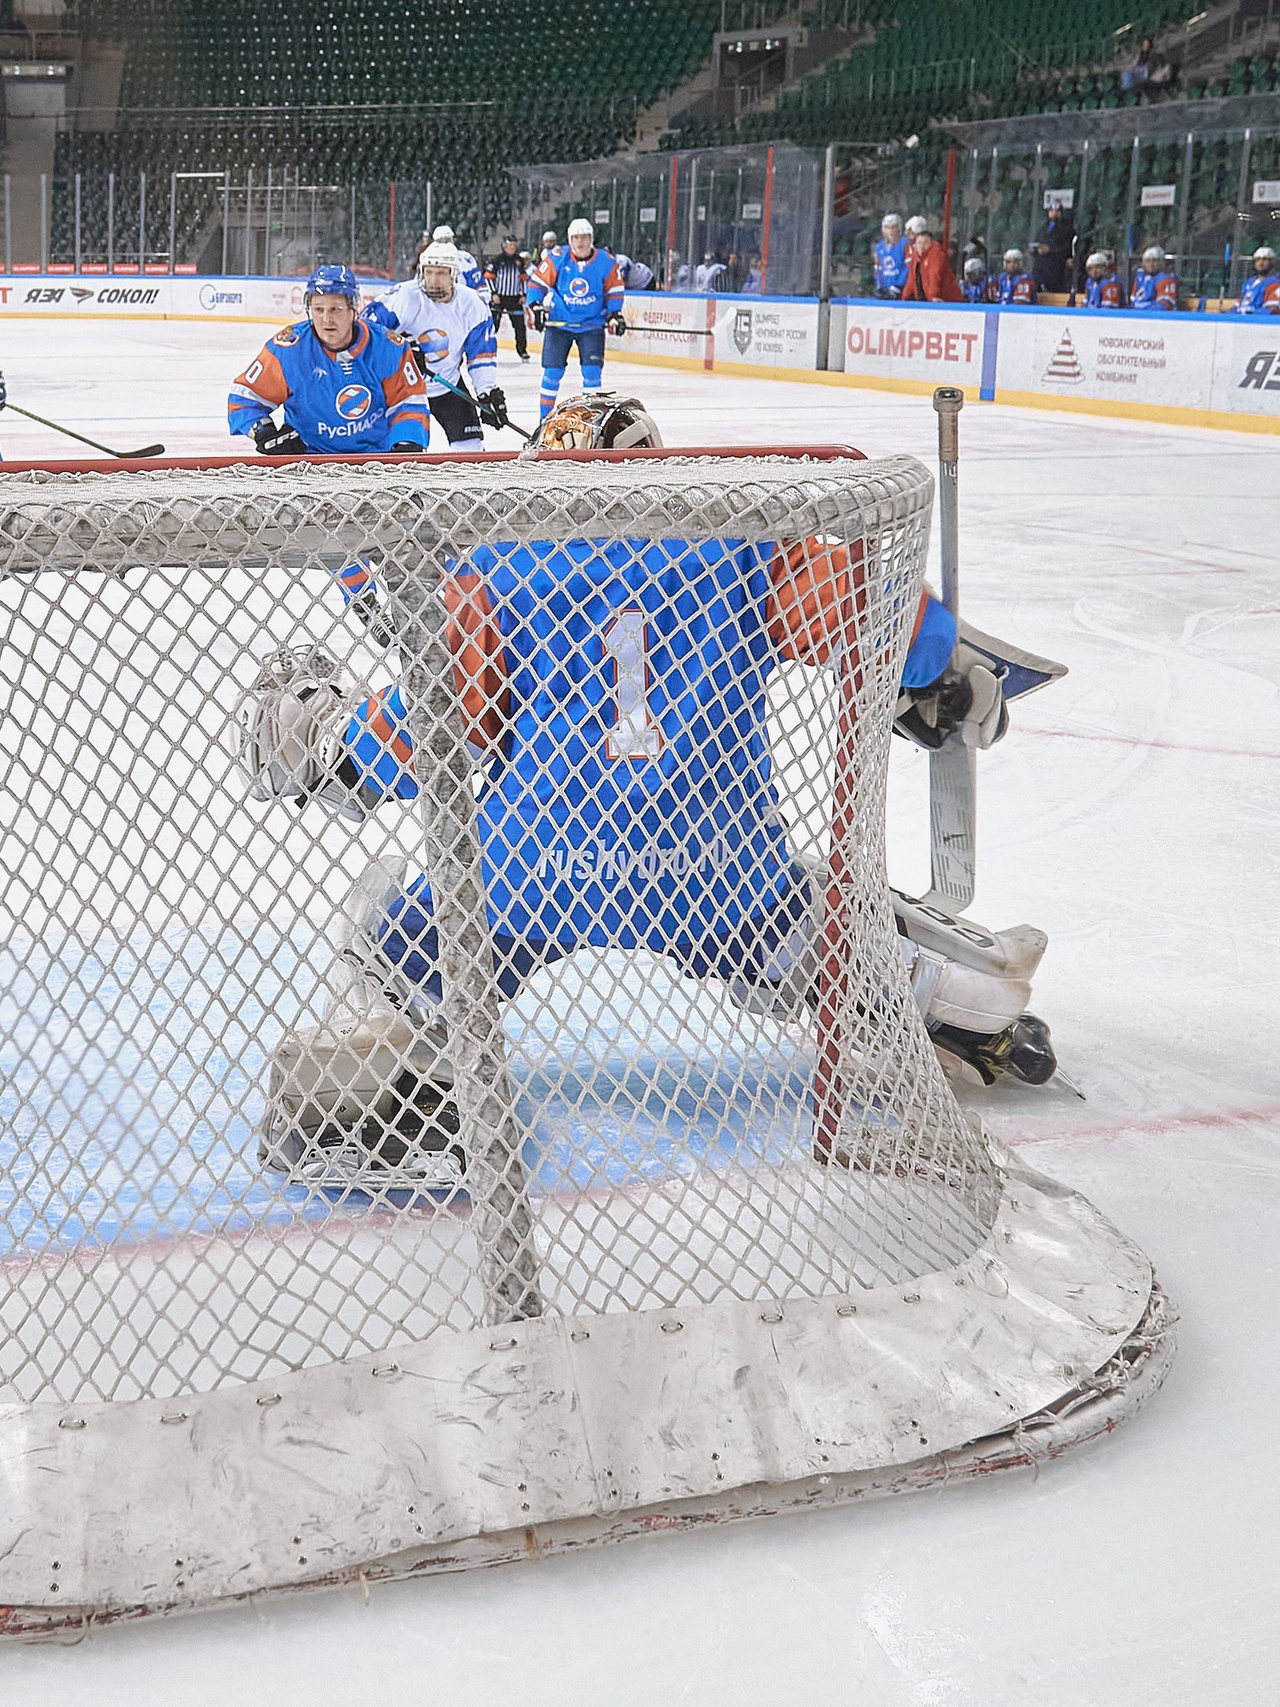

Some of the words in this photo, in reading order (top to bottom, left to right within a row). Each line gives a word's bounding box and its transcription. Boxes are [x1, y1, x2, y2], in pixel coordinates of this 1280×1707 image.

[97, 288, 160, 304] СОКОЛ!
[847, 326, 978, 363] OLIMPBET
[1098, 336, 1165, 351] НОВОАНГАРСКИЙ
[1097, 353, 1167, 369] ОБОГАТИТЕЛЬНЫЙ
[245, 360, 264, 385] 0
[403, 361, 419, 387] 8
[1095, 371, 1138, 384] КОМБИНАТ
[602, 608, 665, 761] 1
